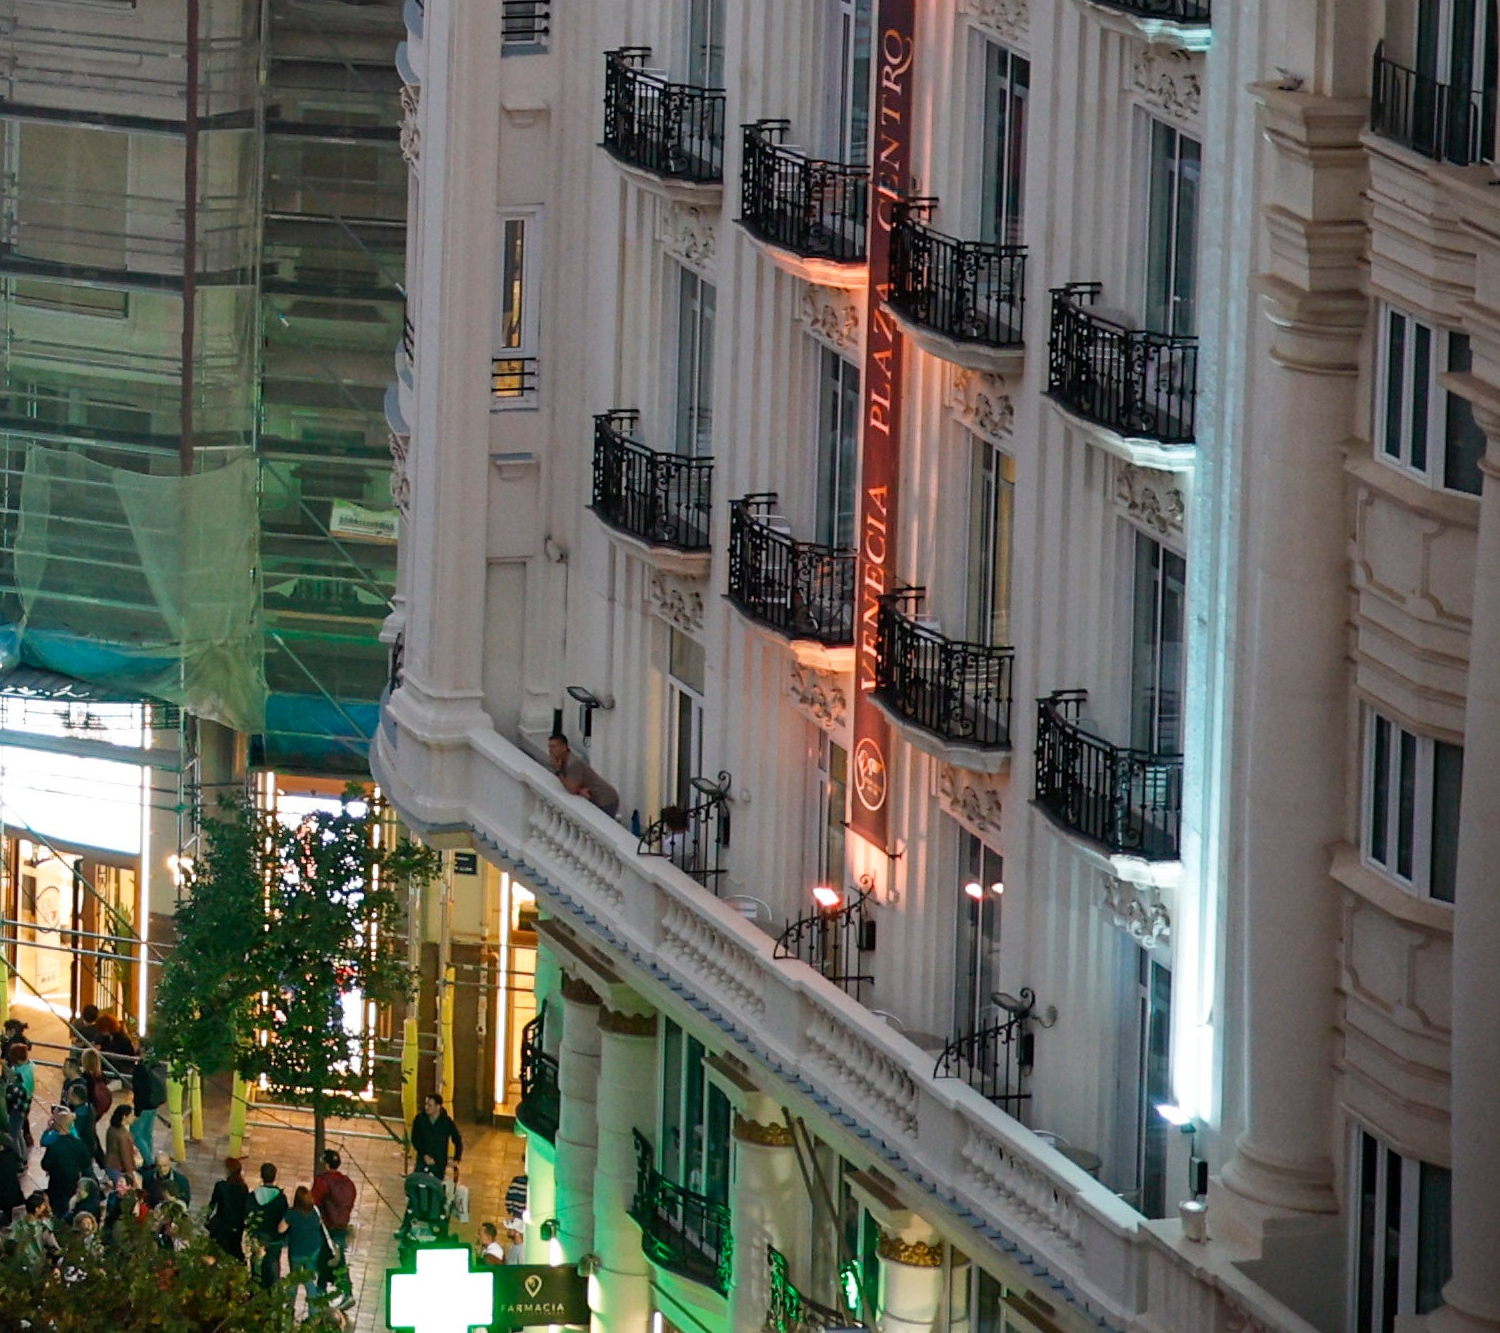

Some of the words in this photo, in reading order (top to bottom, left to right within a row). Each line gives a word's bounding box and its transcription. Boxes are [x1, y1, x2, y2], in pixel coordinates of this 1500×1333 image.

[878, 29, 914, 233] CENTRO
[870, 283, 894, 435] PLAZA
[861, 484, 889, 692] VENECIA
[501, 1302, 565, 1313] FARMACIA
